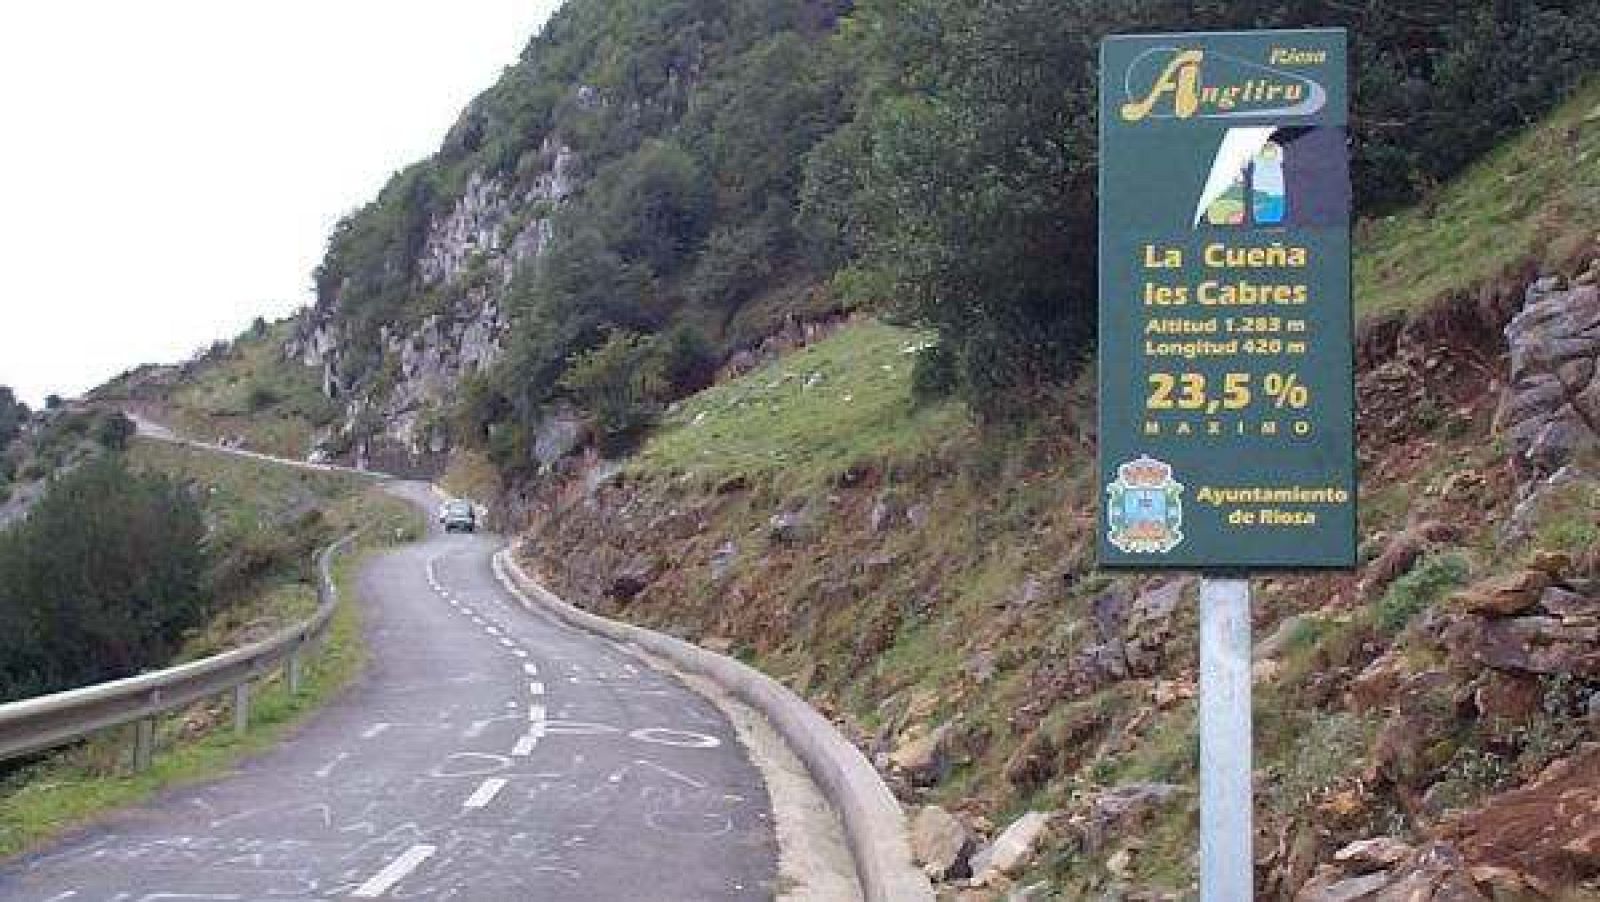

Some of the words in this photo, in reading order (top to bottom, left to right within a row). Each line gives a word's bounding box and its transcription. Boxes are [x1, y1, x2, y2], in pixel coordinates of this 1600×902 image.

[1120, 49, 1303, 121] Angliru
[1145, 244, 1182, 268] La
[1203, 241, 1308, 268] Cueña
[1144, 282, 1188, 305] les
[1197, 279, 1308, 305] Cabres
[1145, 317, 1217, 334] Altitud
[1287, 319, 1305, 332] m
[1145, 339, 1238, 358] Longitud
[1287, 341, 1305, 353] m
[1146, 372, 1252, 415] 23,5
[1262, 372, 1308, 408] %
[1196, 486, 1348, 506] Ayuntamiento
[1228, 508, 1255, 525] de
[1260, 508, 1316, 525] Riosa
